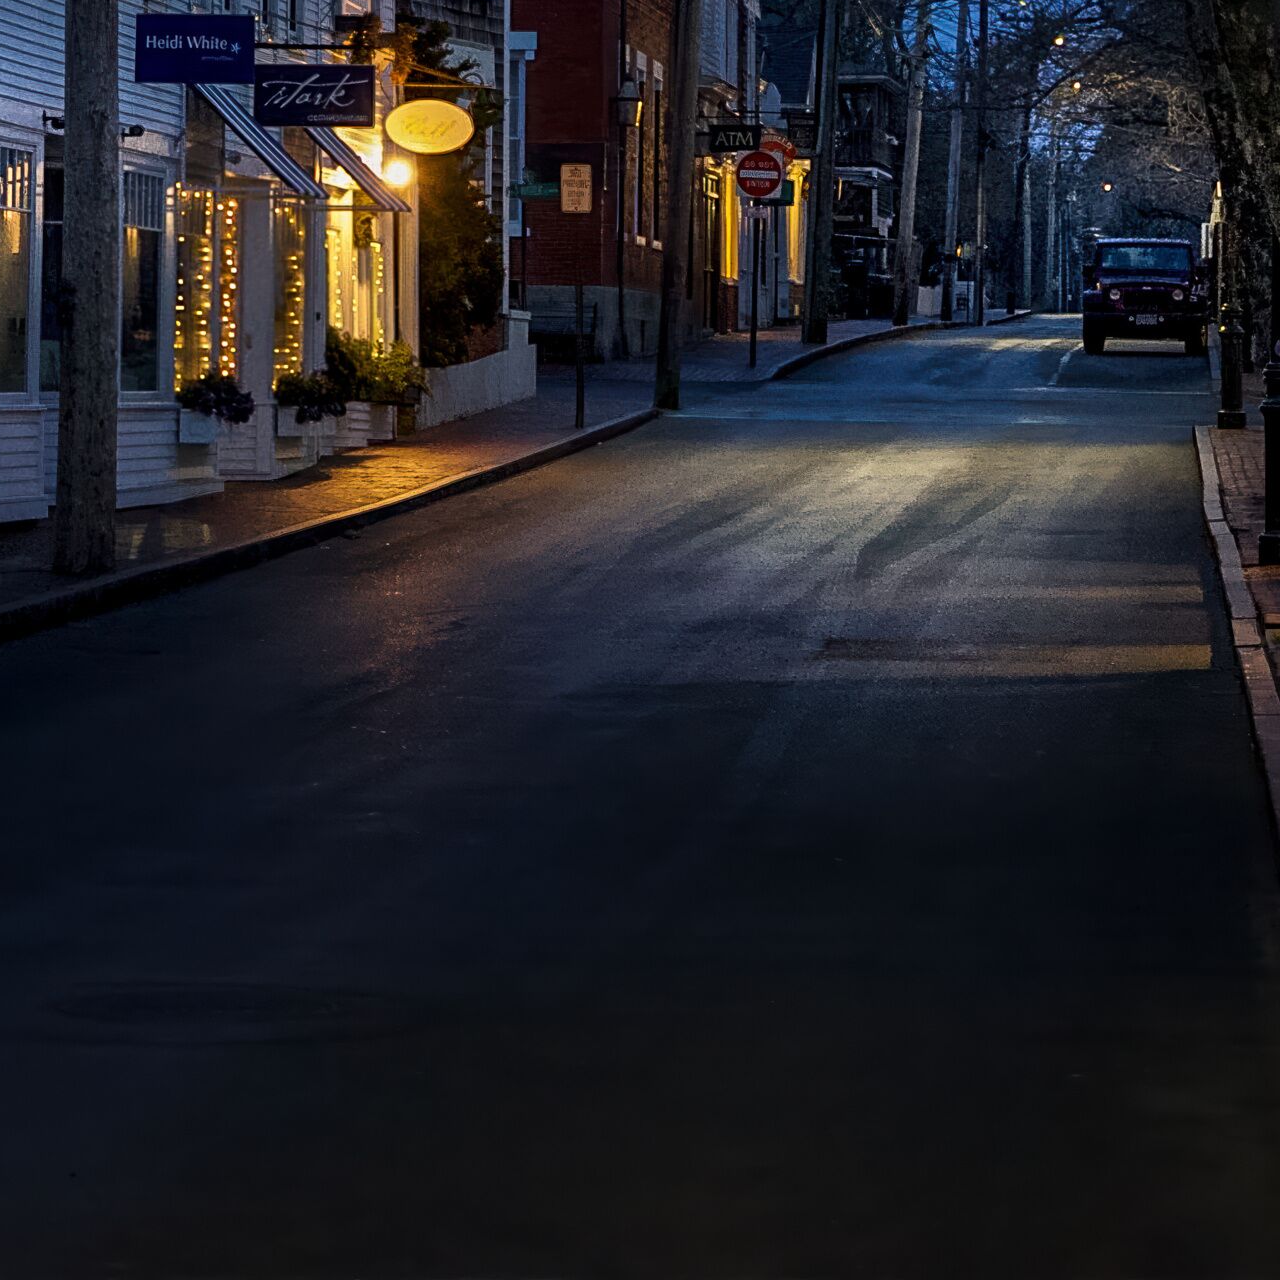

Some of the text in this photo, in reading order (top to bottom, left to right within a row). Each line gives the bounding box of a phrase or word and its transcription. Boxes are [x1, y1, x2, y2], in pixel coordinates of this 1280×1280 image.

[145, 34, 228, 50] Heidi White
[715, 131, 754, 147] ATM
